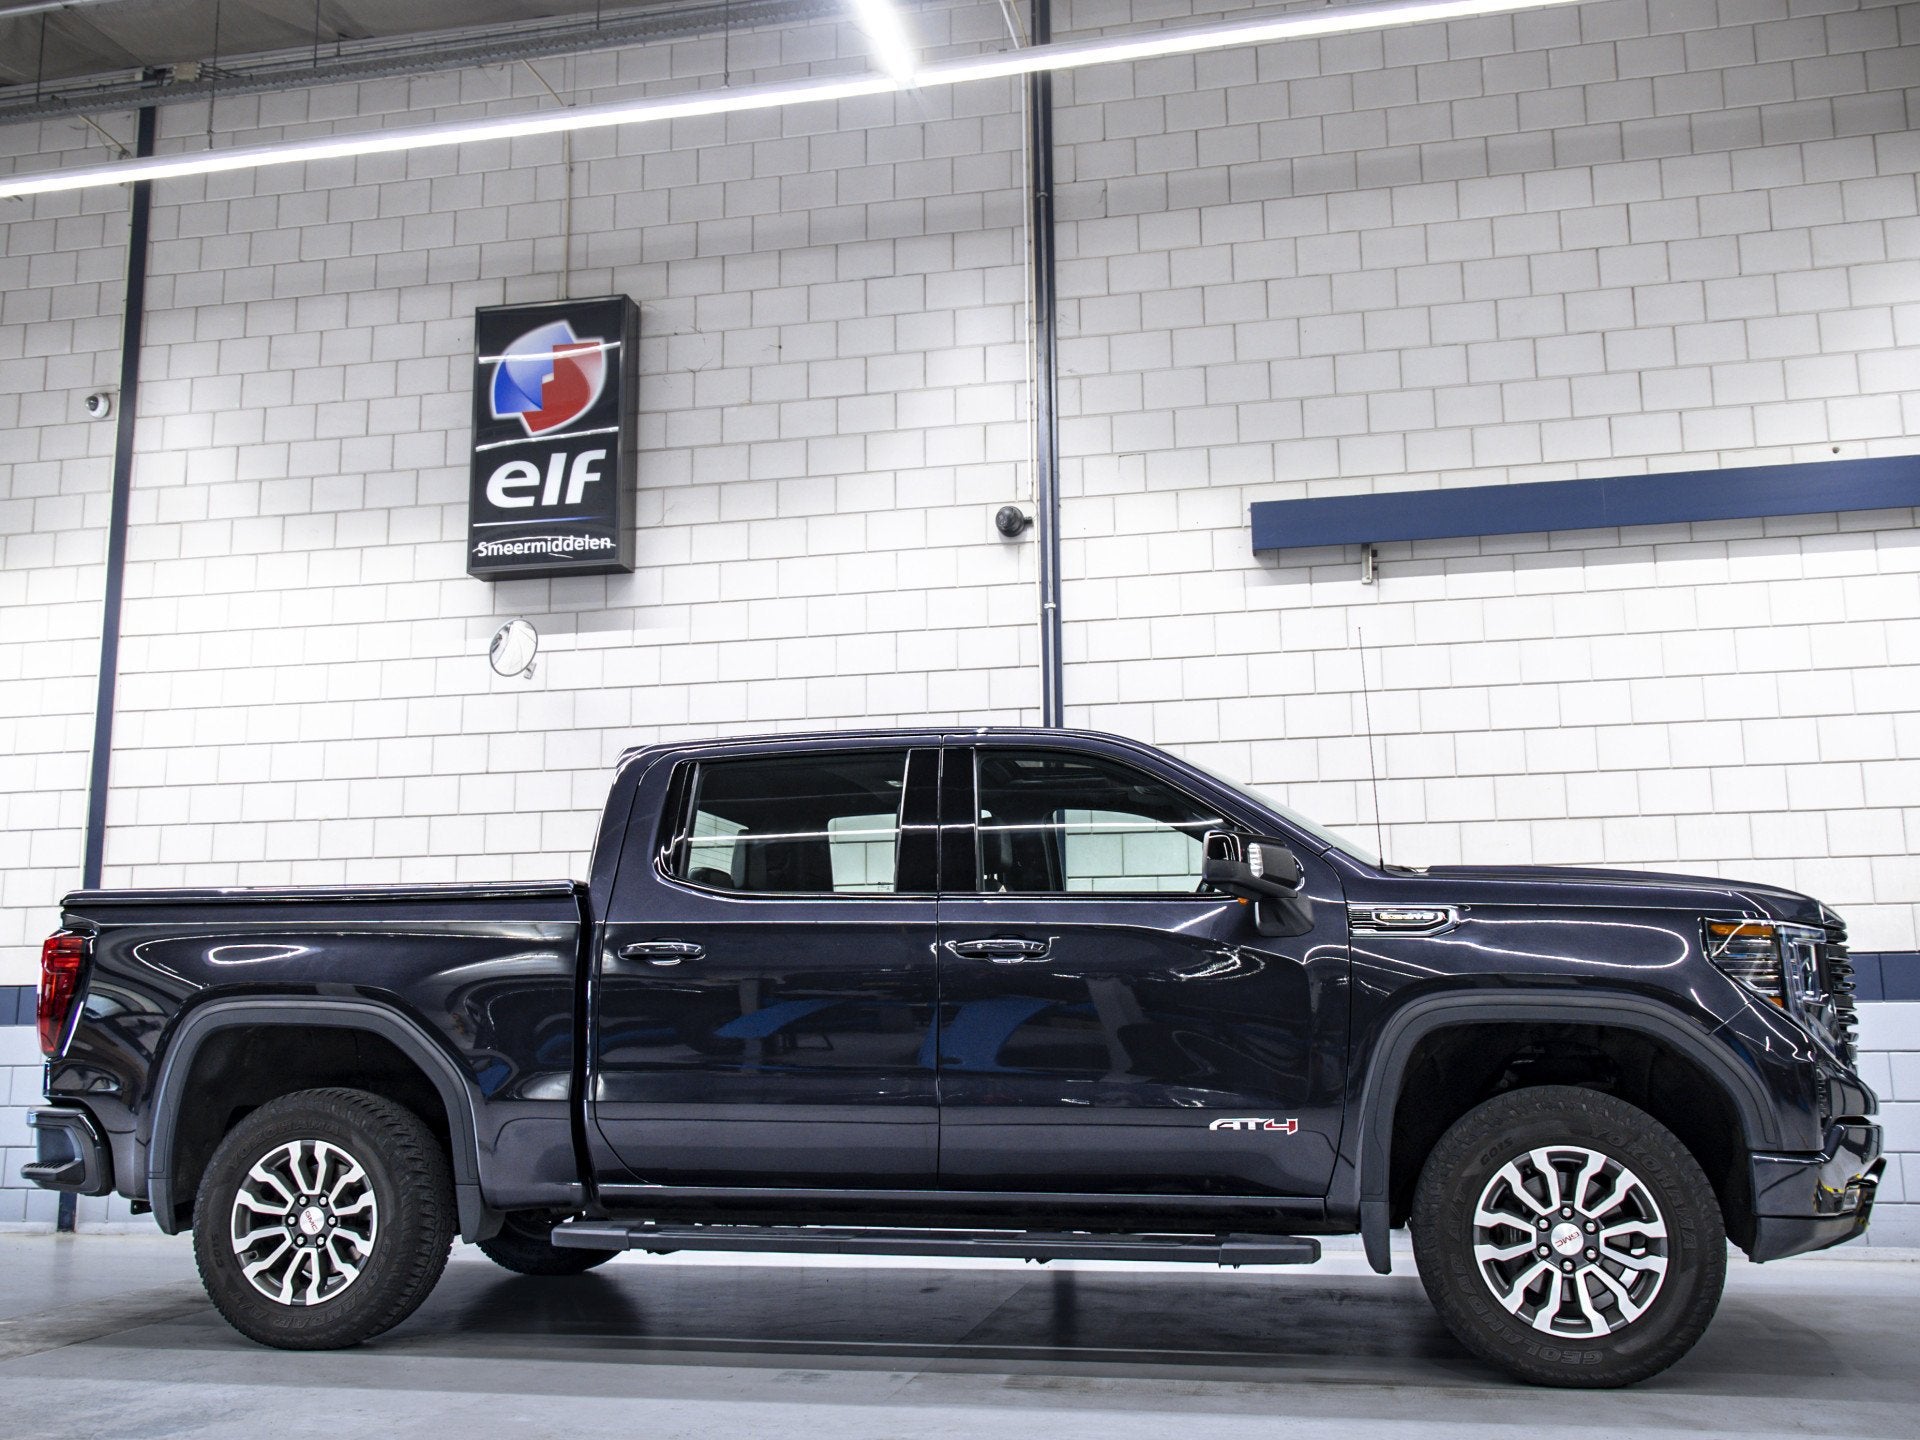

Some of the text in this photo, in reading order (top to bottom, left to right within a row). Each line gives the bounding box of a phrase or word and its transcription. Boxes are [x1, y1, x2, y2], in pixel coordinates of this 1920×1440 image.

[486, 449, 606, 508] elf
[477, 534, 611, 557] Smeermiddelen
[1209, 1117, 1298, 1135] AT4
[1590, 1123, 1696, 1250] YOKOHAMA
[305, 1210, 318, 1232] GMC
[1555, 1231, 1580, 1247] GMC
[1449, 1253, 1604, 1366] GEOLANDAR
